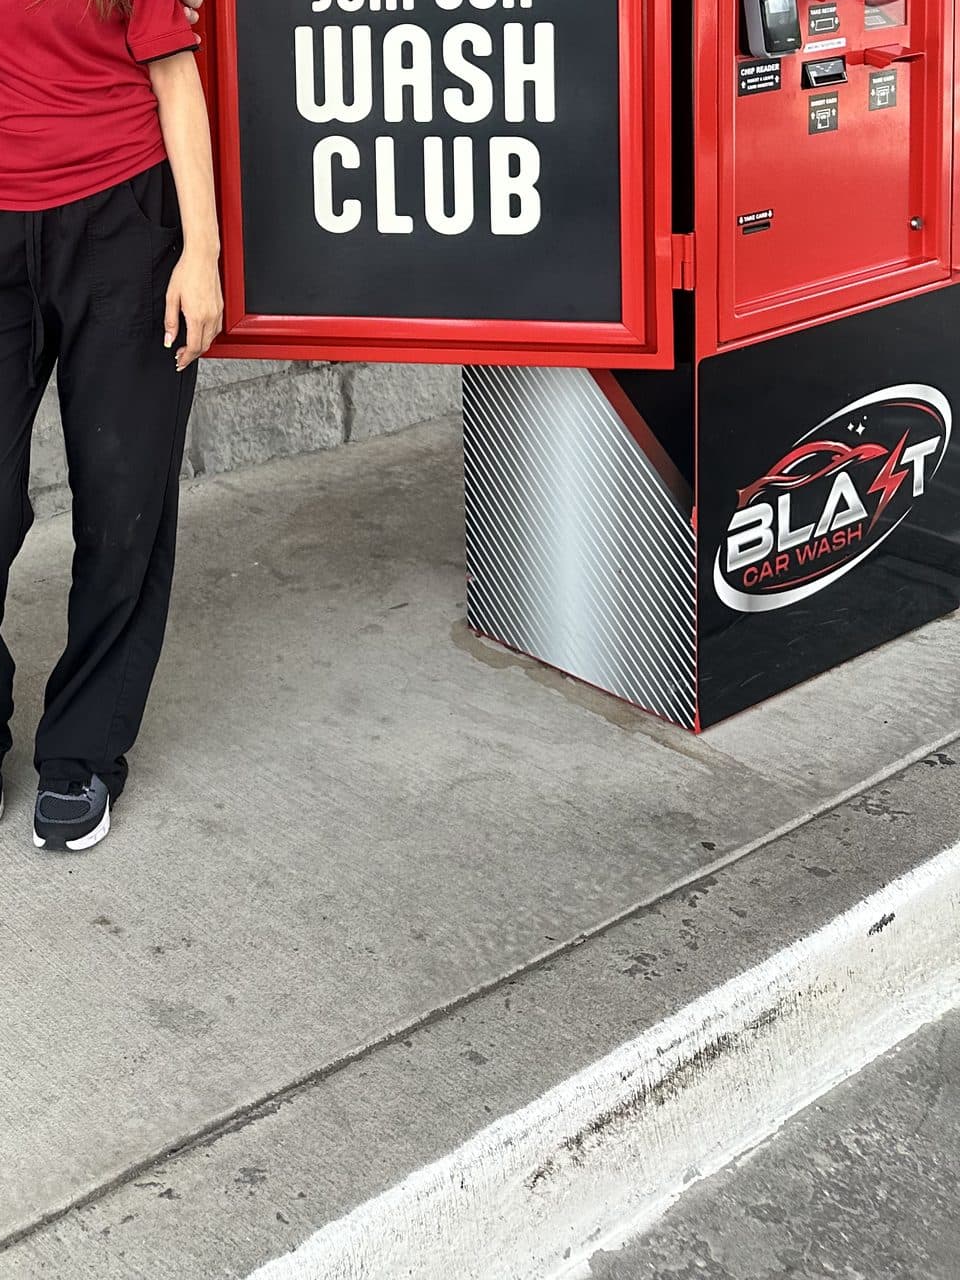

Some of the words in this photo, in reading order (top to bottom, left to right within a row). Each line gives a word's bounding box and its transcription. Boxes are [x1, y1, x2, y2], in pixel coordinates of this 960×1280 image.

[294, 22, 556, 124] WASH
[741, 67, 755, 76] CHIP
[756, 63, 780, 73] READER
[312, 135, 541, 235] CLUB
[743, 553, 790, 587] CAR
[795, 522, 863, 566] WASH
